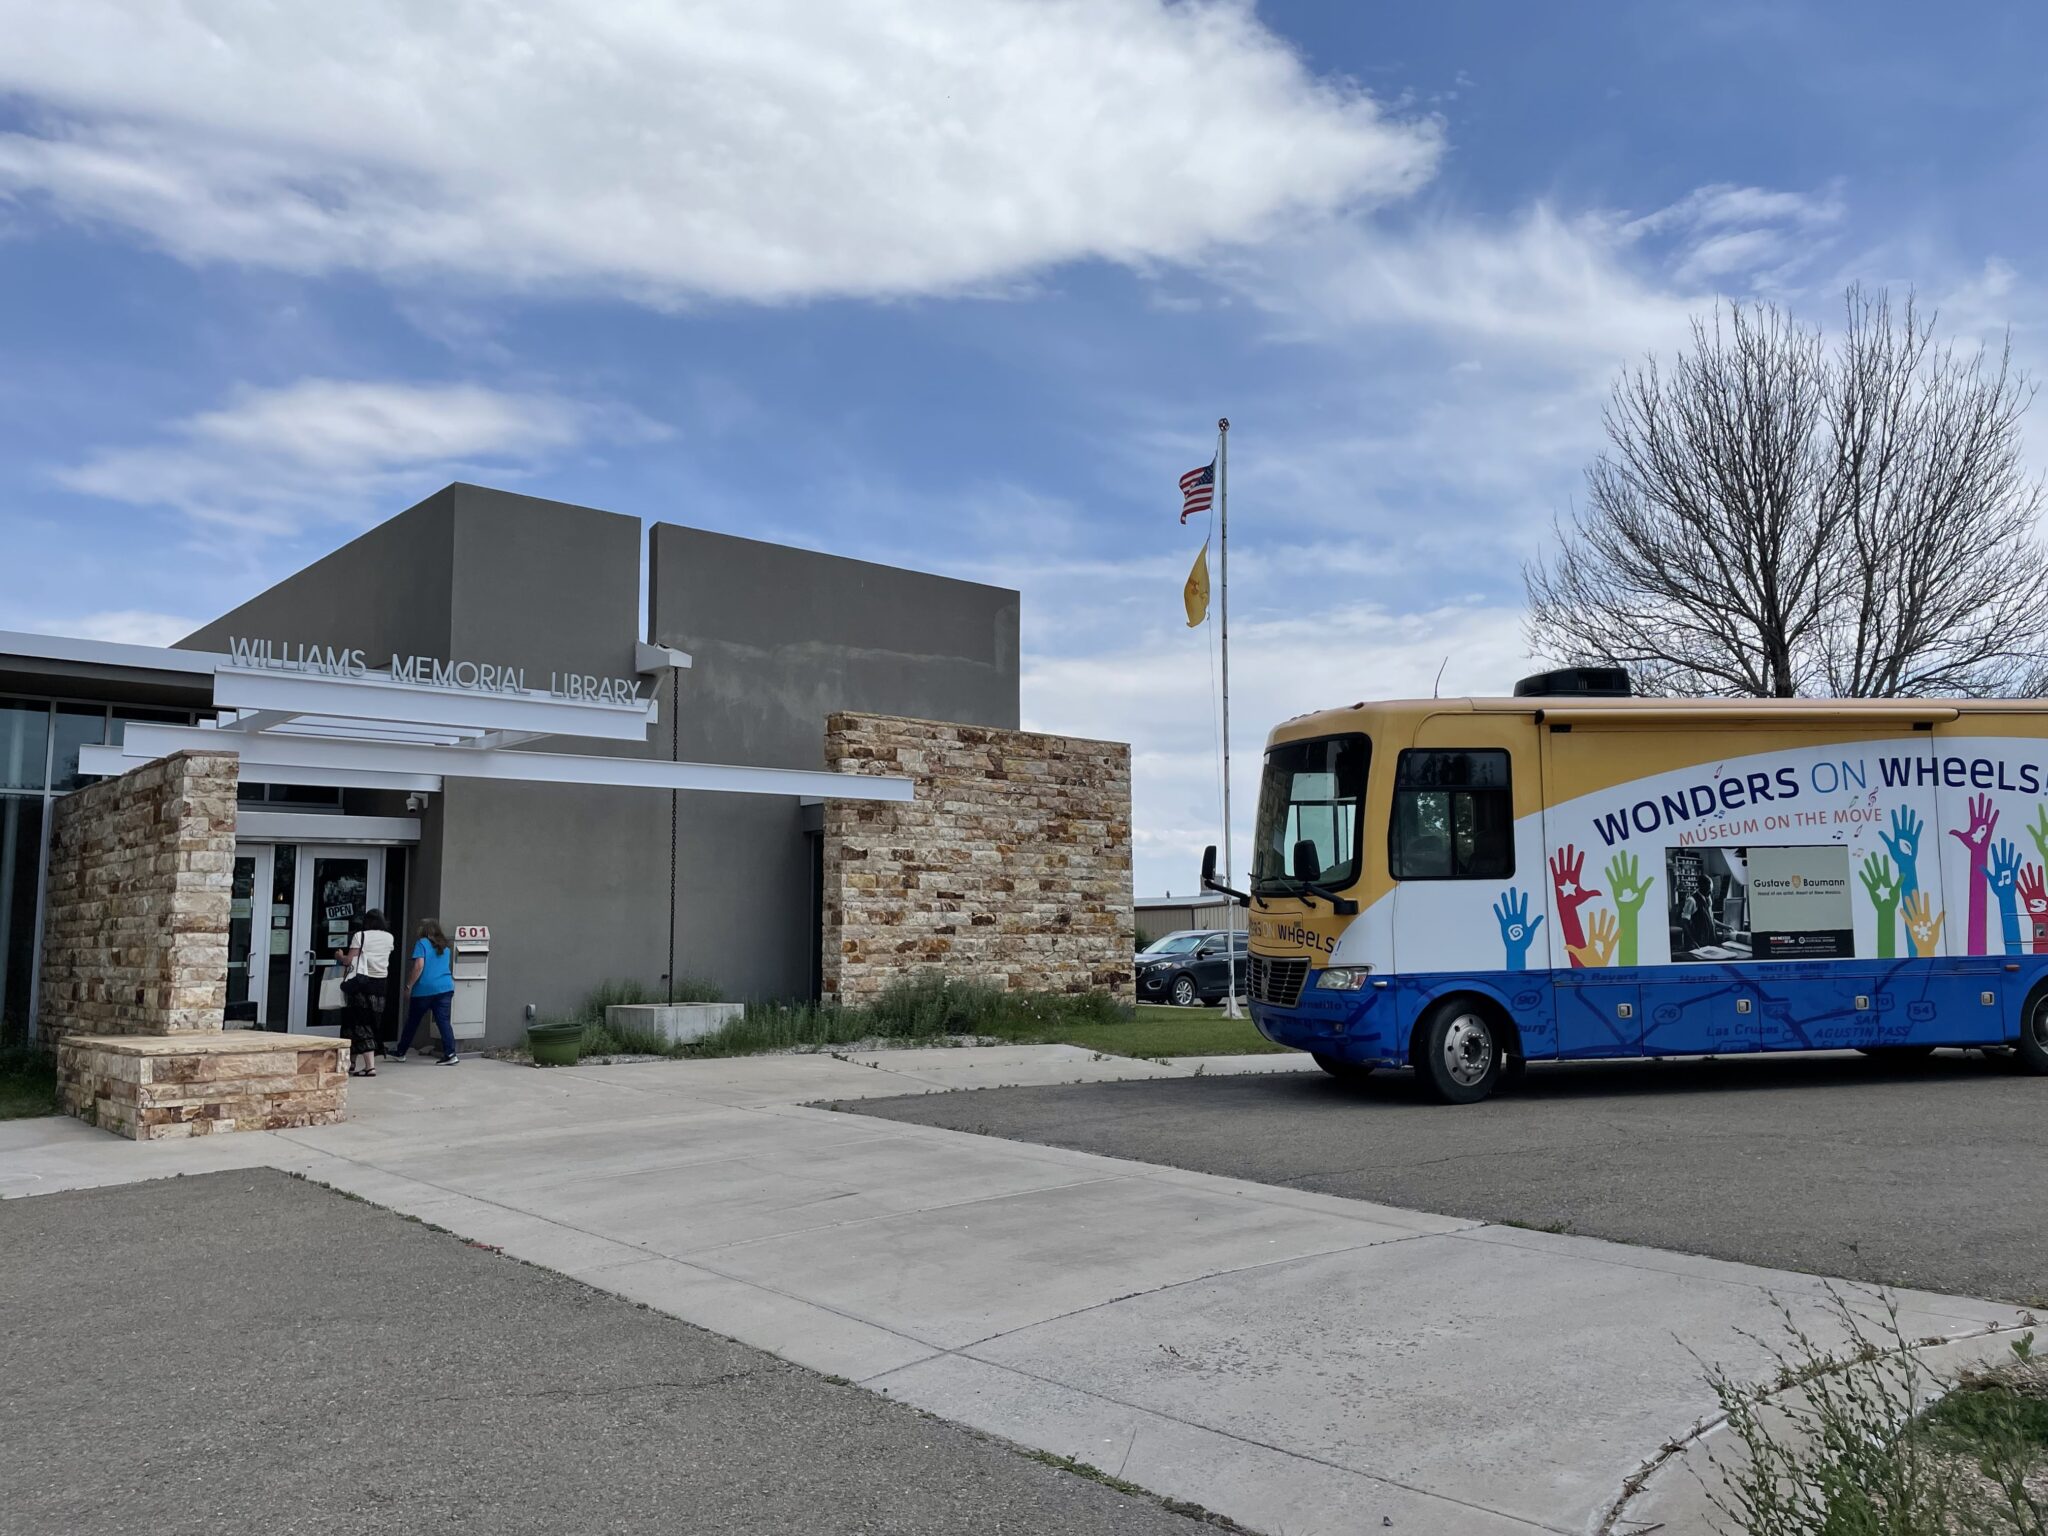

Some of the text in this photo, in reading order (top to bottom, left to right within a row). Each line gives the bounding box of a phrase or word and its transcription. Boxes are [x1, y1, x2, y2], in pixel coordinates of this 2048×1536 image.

[230, 636, 642, 704] WILLIAMS MEMORIAL LIBRARY
[1811, 759, 1867, 794] ON
[1679, 807, 1883, 848] MUSEUM ON THE MOVE
[1753, 878, 1845, 888] Gustave Baumann
[328, 904, 352, 918] OPEN
[458, 927, 486, 938] 601
[1658, 1008, 1676, 1019] 26
[1706, 1024, 1779, 1037] Las Cruces
[1814, 1027, 1874, 1039] AGUSTIN
